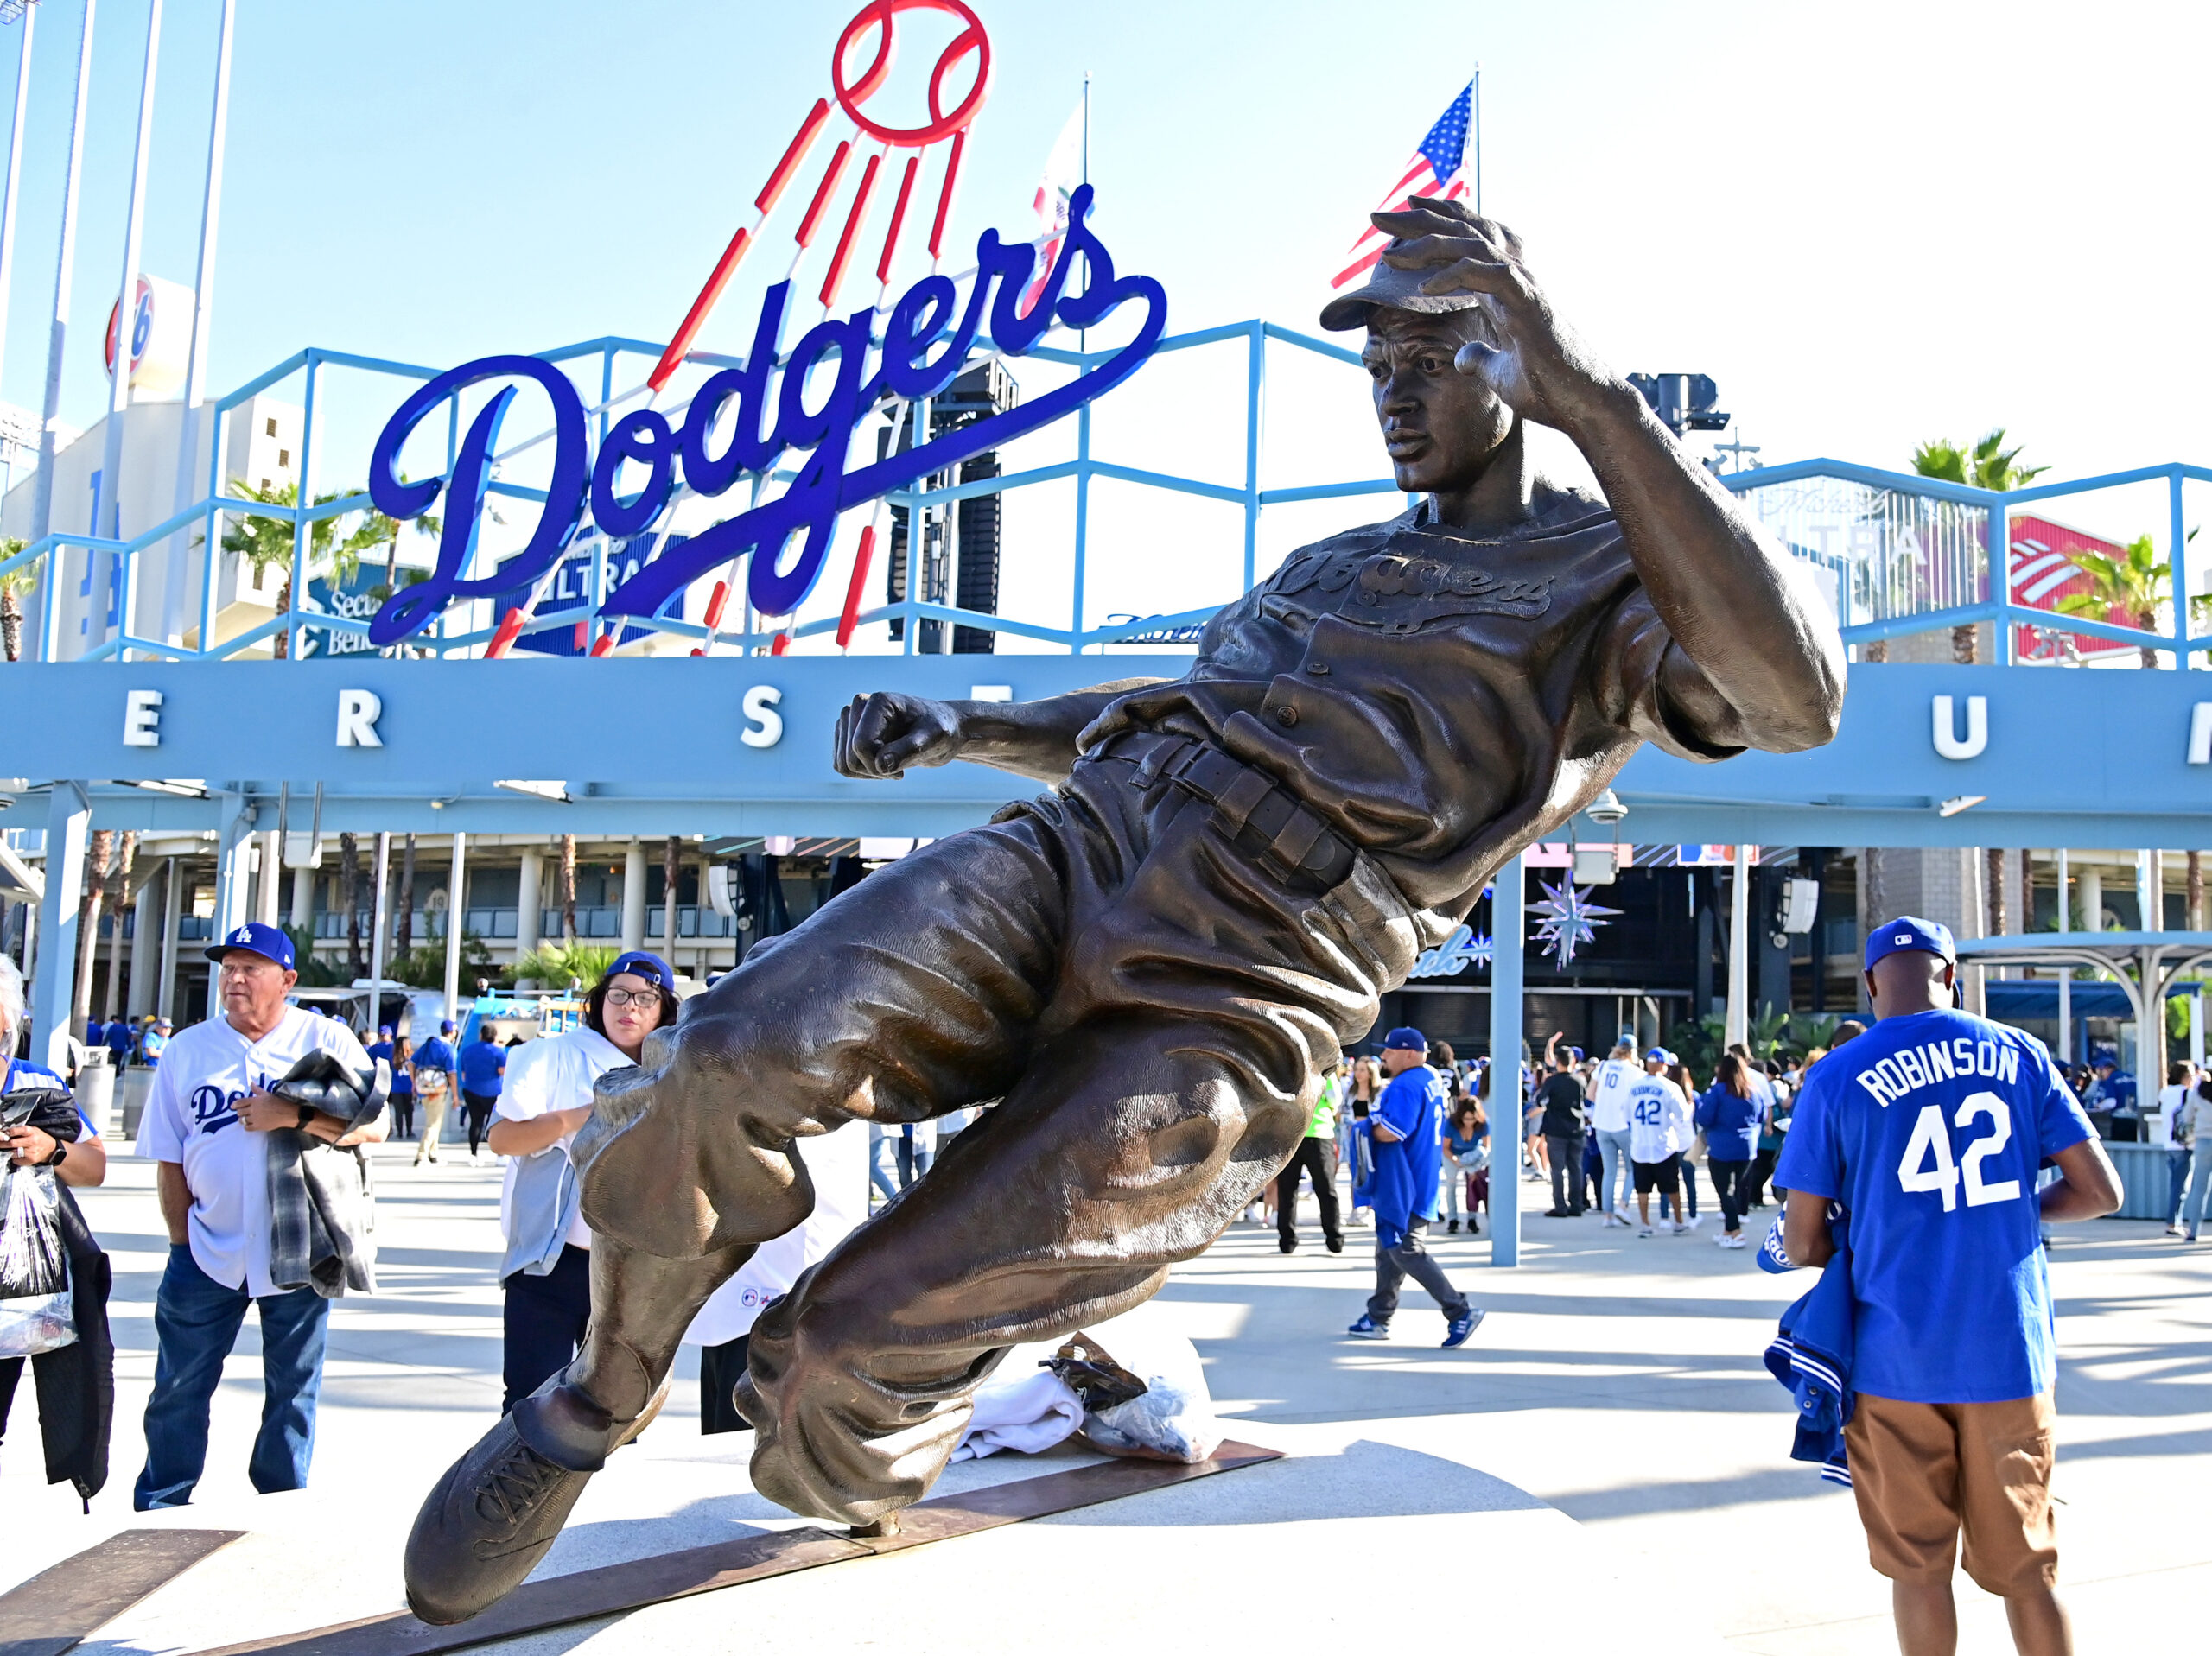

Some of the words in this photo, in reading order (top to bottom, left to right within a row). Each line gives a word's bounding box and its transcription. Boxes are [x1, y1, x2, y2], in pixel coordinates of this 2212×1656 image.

[369, 183, 1167, 644] Dodgers
[1777, 525, 1928, 566] LTRA
[235, 925, 253, 943] LA
[1604, 1072, 1619, 1089] 10
[1855, 1037, 2020, 1109] ROBINSON
[1634, 1100, 1662, 1126] 42
[1897, 1090, 2021, 1213] 42
